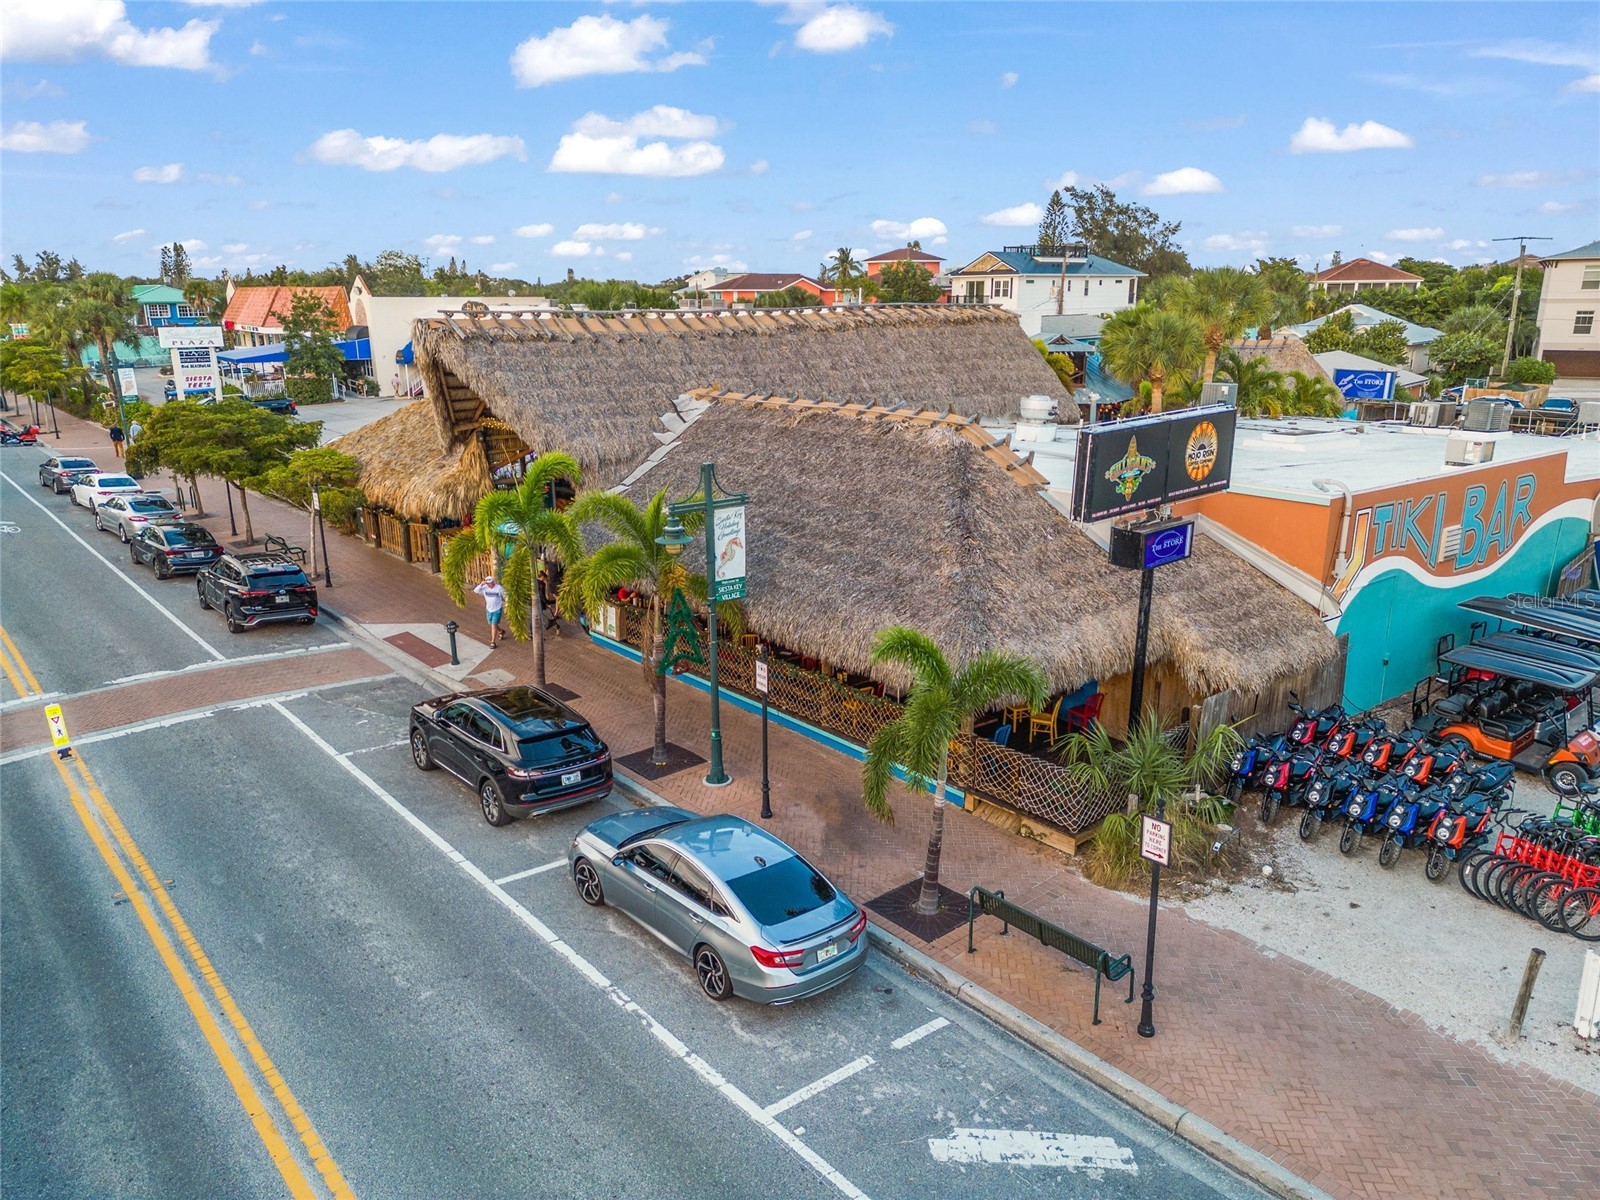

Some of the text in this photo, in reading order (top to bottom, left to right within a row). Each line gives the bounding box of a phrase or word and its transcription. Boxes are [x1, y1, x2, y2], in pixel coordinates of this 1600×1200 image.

[1187, 450, 1201, 461] MOJO
[1372, 473, 1537, 572] TIKI BAR
[1163, 535, 1184, 549] STORE
[718, 585, 733, 593] SIESTA
[721, 592, 741, 601] VILLAGE
[1151, 822, 1161, 832] NO
[1146, 829, 1165, 840] PARKING
[1149, 837, 1162, 846] HERE
